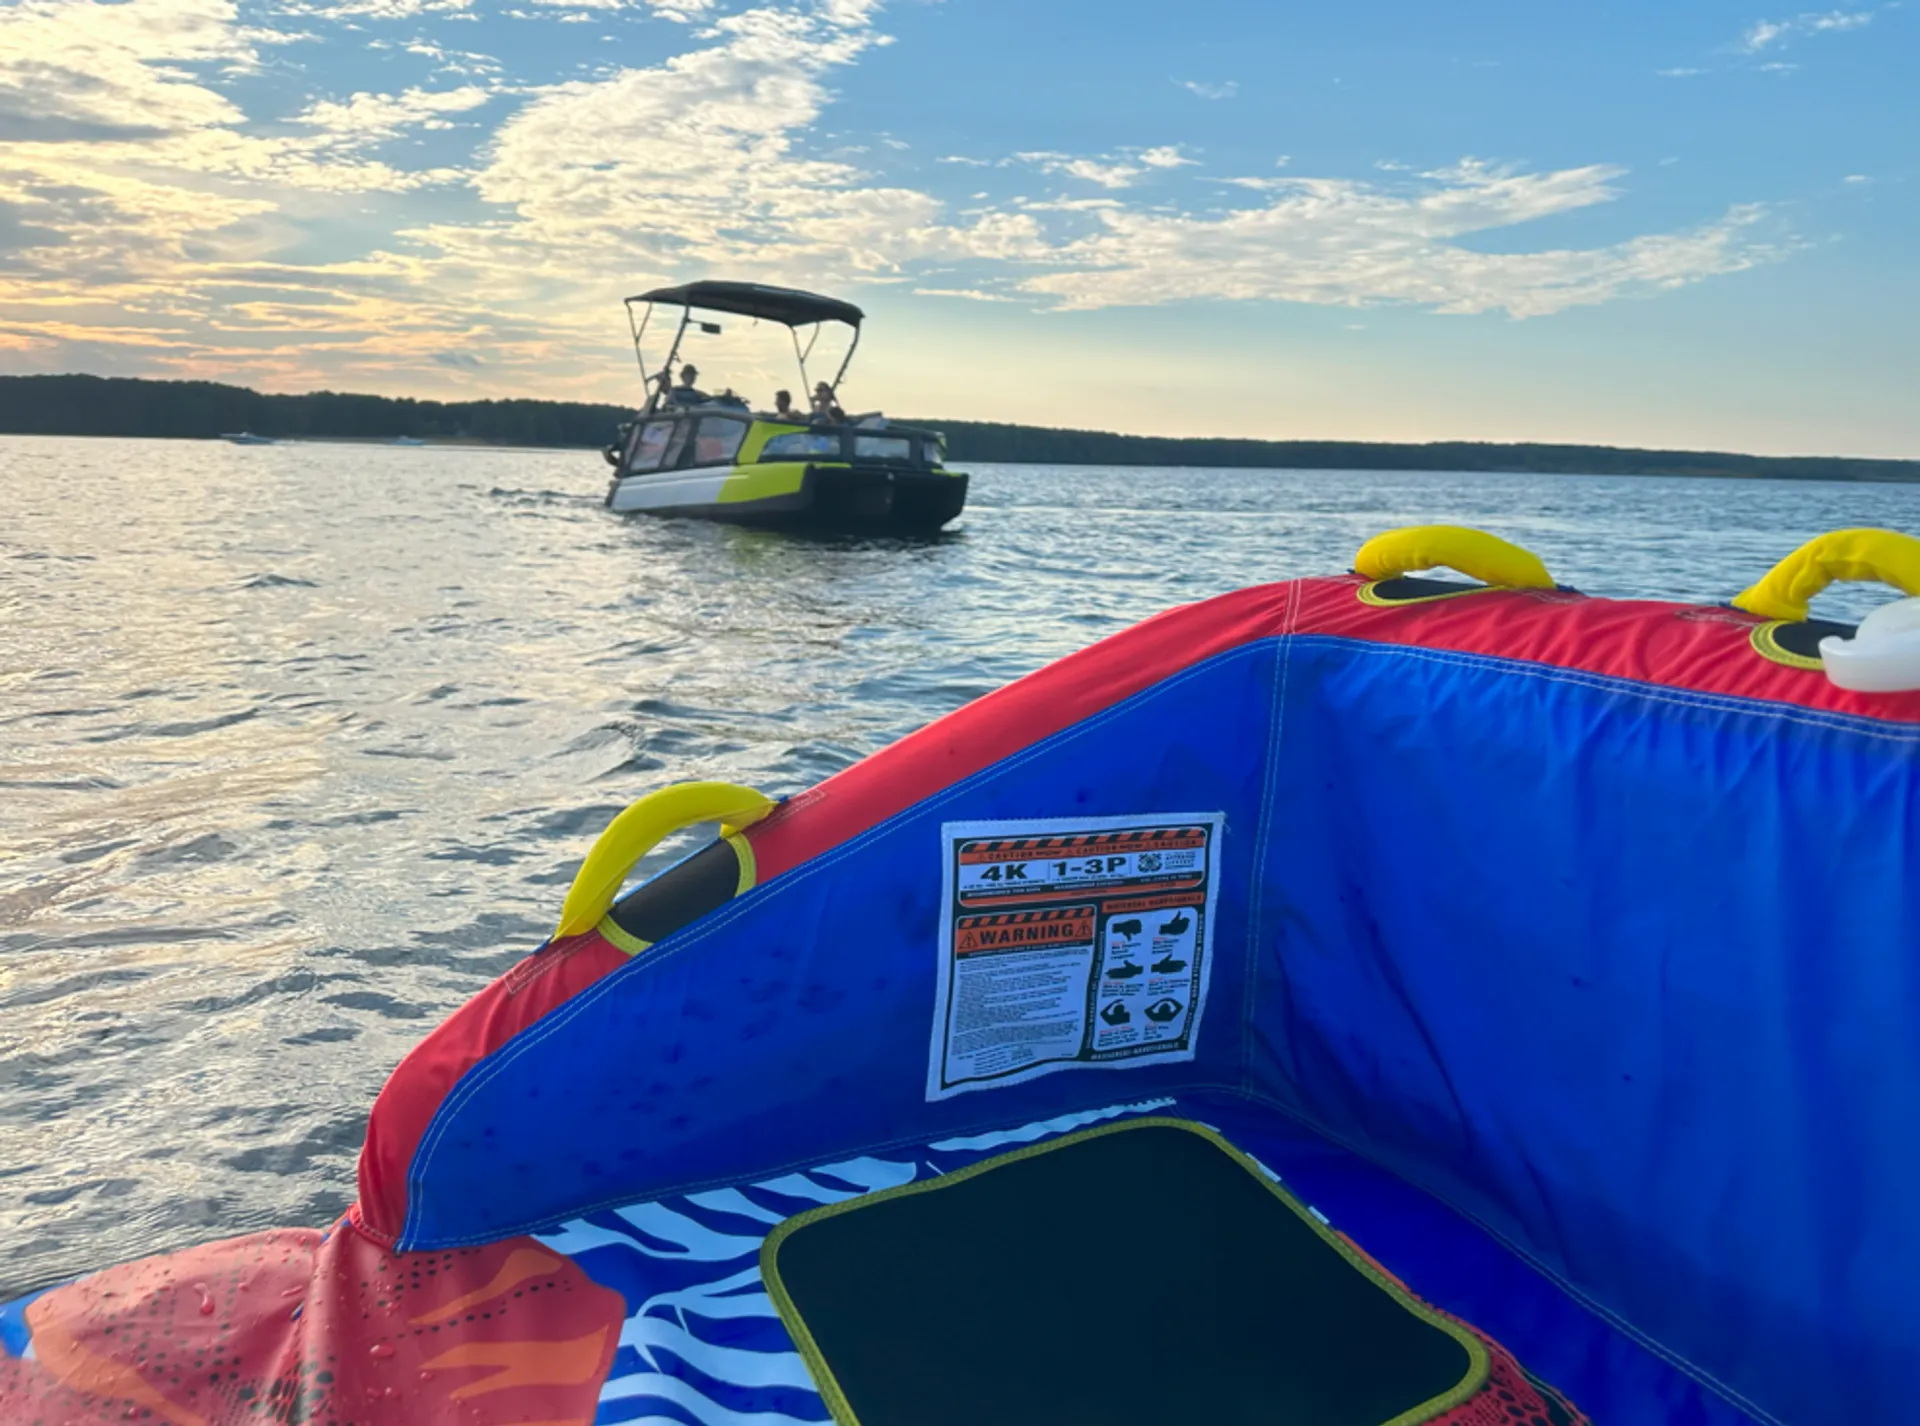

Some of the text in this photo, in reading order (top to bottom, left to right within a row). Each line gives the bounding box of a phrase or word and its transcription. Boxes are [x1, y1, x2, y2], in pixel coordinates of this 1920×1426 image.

[980, 863, 1028, 881] 4K
[1052, 856, 1127, 876] 1-3P
[979, 923, 1075, 946] WARNING
